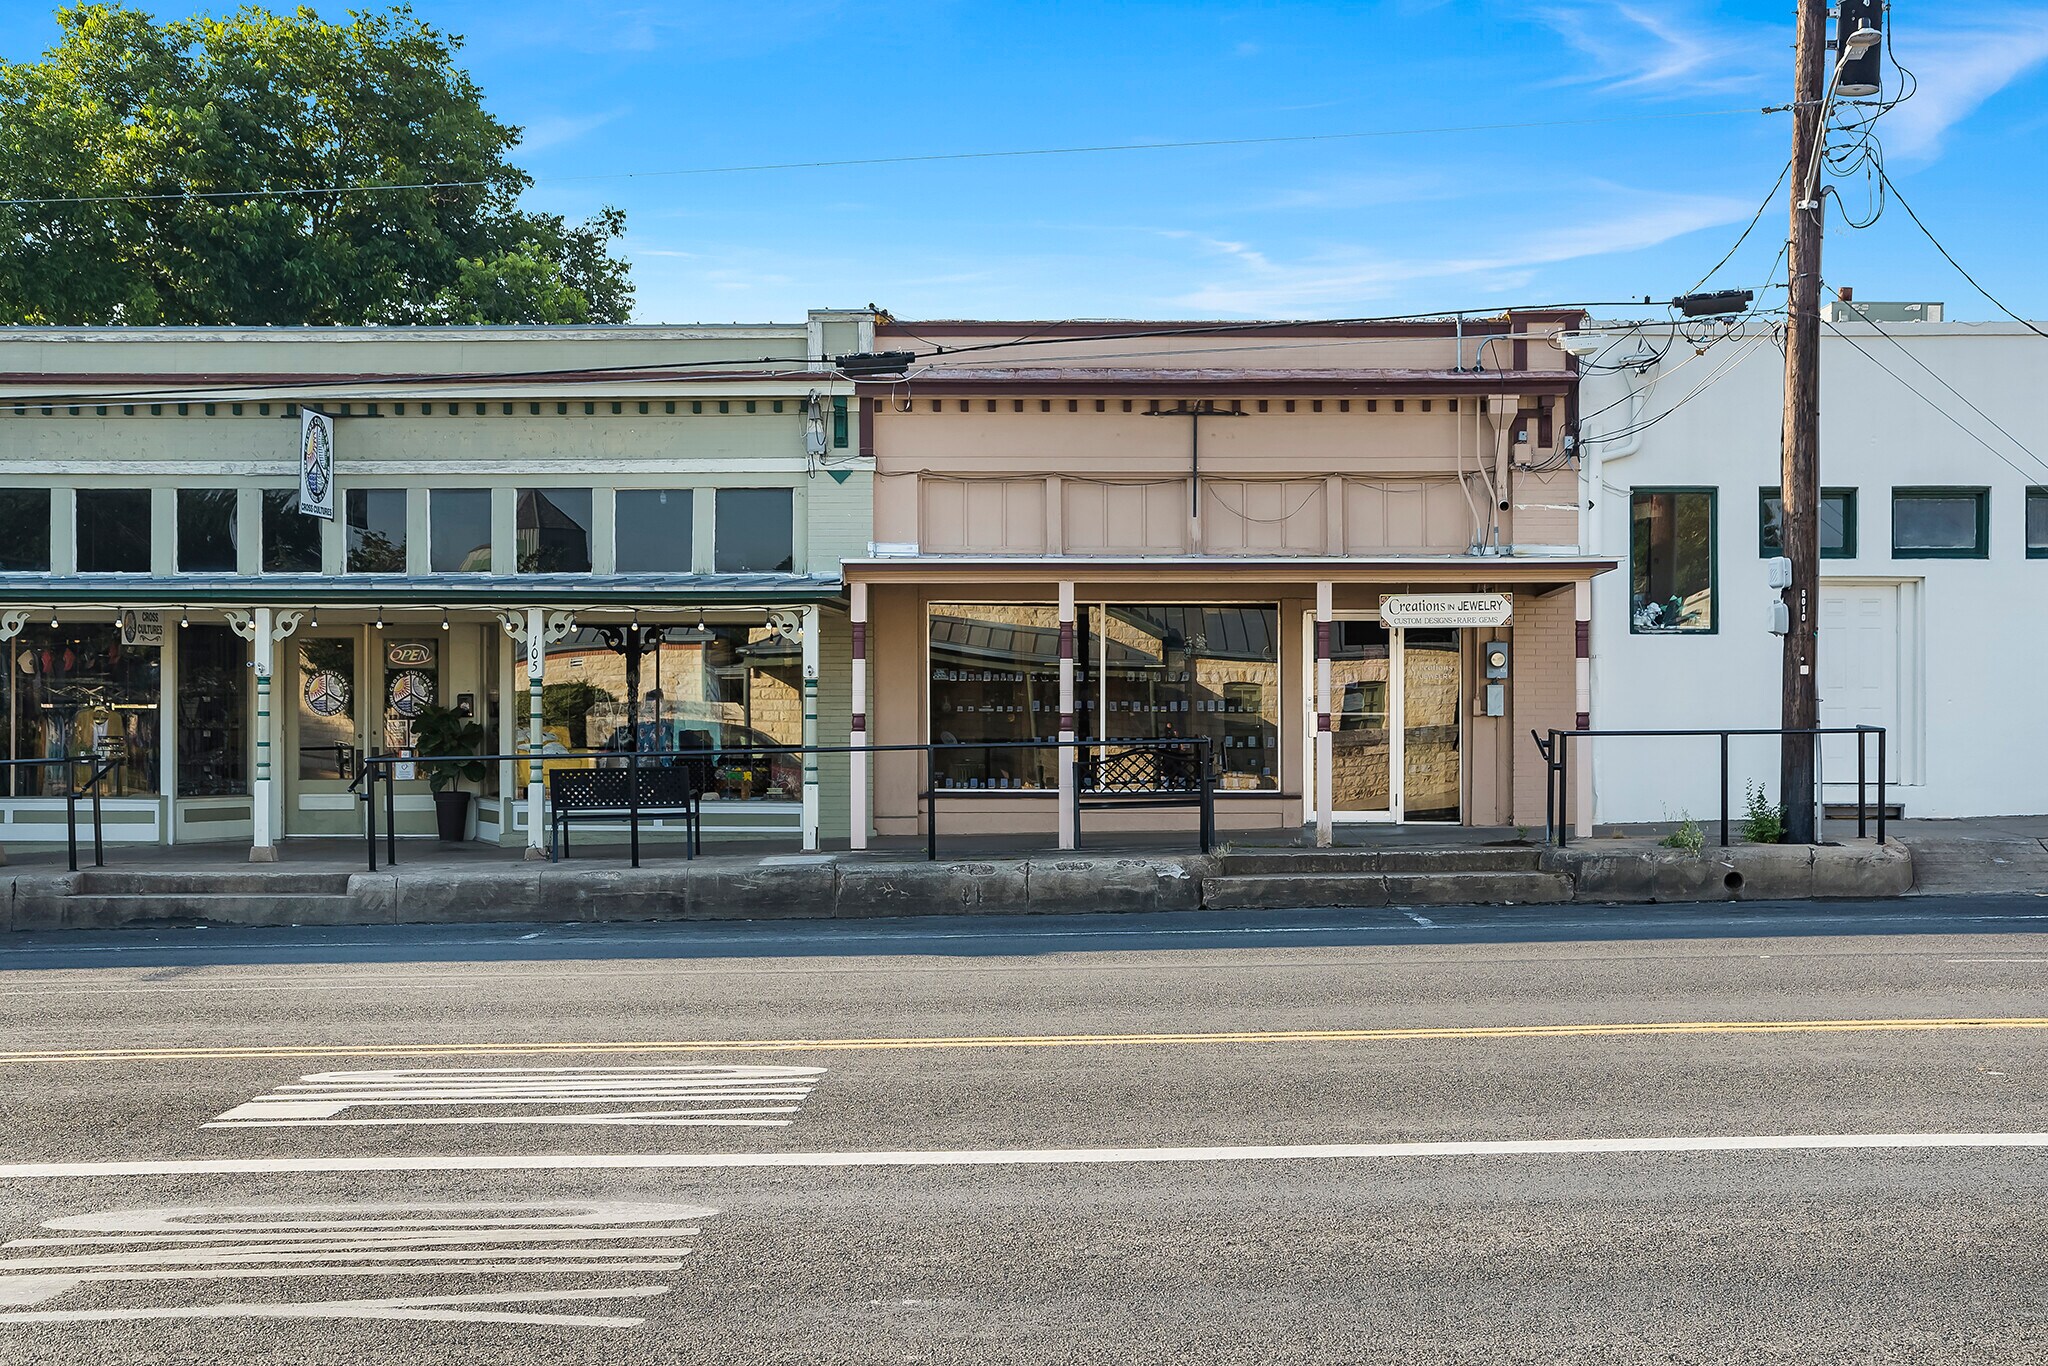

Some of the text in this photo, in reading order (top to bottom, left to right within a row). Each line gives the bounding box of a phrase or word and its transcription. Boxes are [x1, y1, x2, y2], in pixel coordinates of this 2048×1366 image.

[1388, 599, 1446, 615] Creations
[1458, 600, 1503, 611] JEWELRY
[142, 612, 159, 622] CROSS
[137, 624, 163, 635] CULTURES
[389, 649, 430, 661] OPEN
[531, 635, 539, 673] 105
[321, 670, 349, 691] CULTURES
[405, 670, 434, 691] CULTURES
